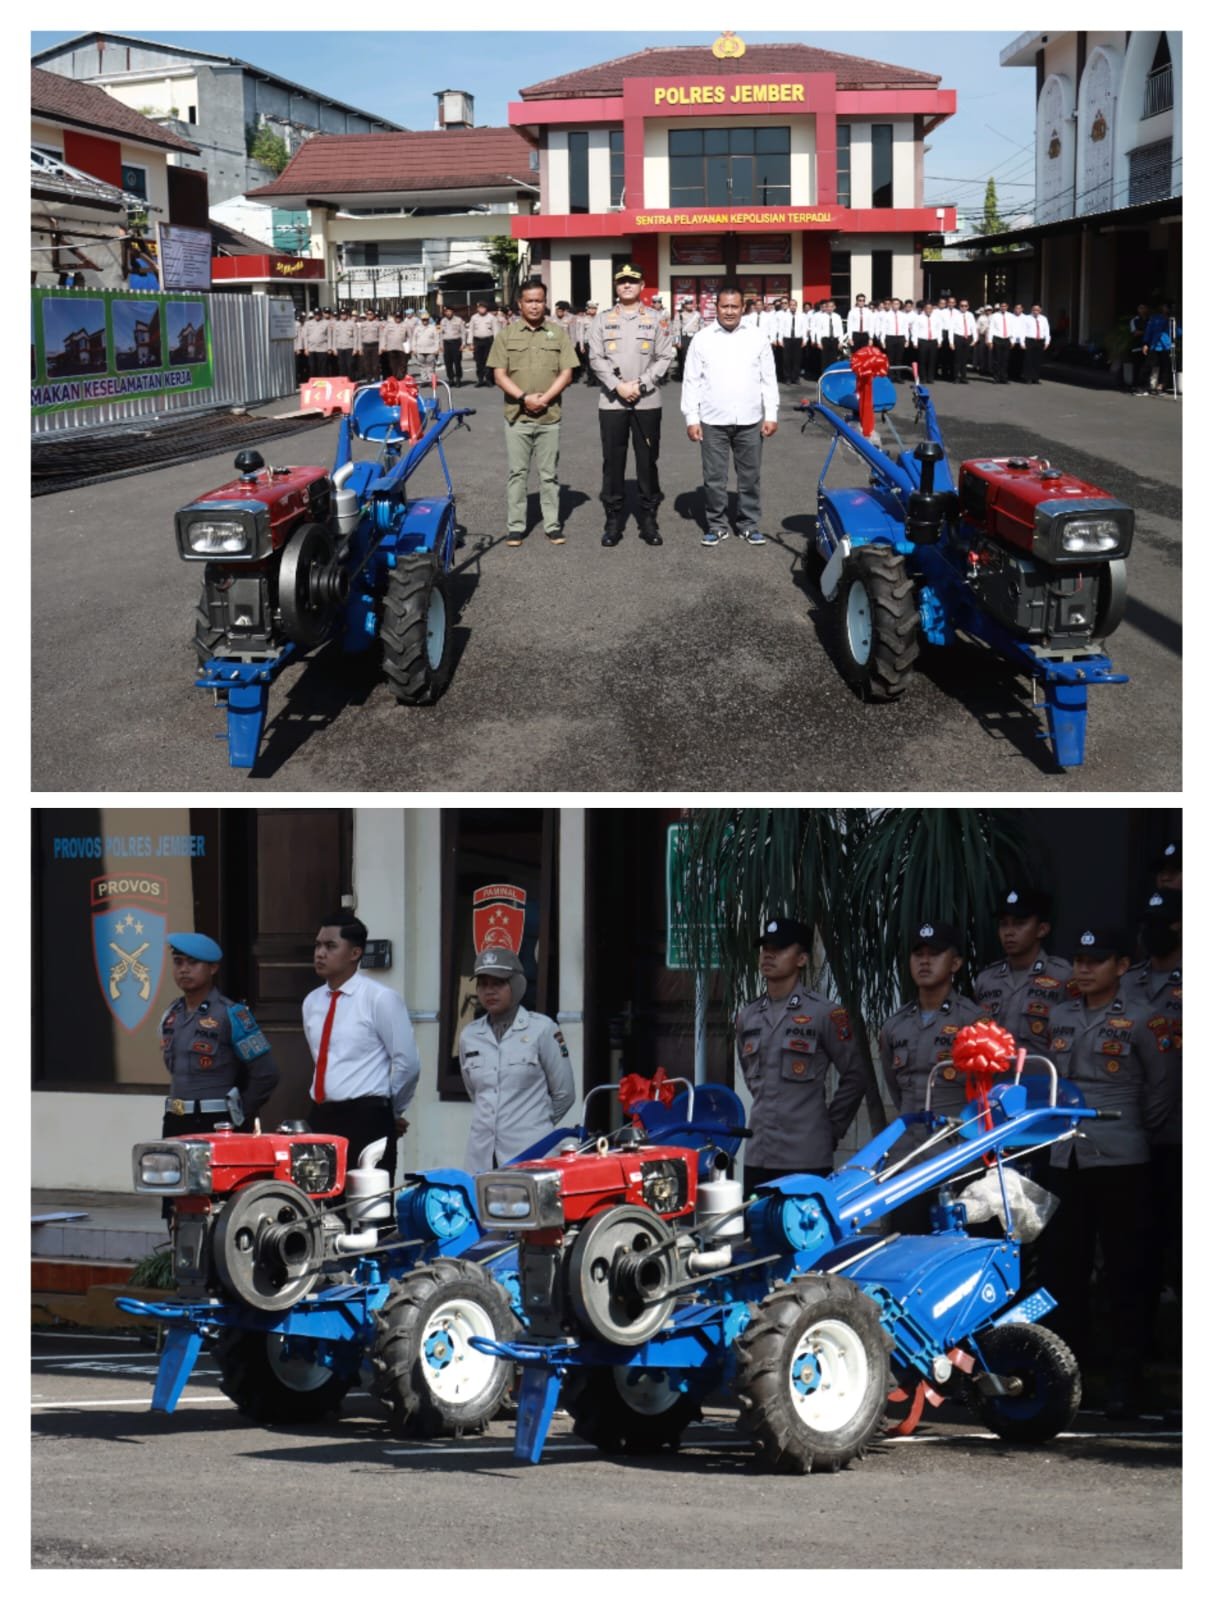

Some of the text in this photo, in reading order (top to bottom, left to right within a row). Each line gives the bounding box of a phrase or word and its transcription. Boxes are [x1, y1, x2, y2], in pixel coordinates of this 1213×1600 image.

[654, 83, 805, 104] POLRES JEMBER
[635, 212, 831, 225] SENTRA PELAYANAN KEPOLISIAN TERPADU
[84, 375, 162, 397] KESELAMATAN
[164, 370, 192, 387] KERJA
[53, 834, 206, 859] PROVOS POLRES JEMBER
[98, 879, 160, 897] PROVOS
[483, 887, 517, 898] PAMINAL
[1027, 988, 1059, 1000] POLRI
[1166, 1001, 1182, 1010] PO
[785, 1027, 817, 1037] POLRI
[1098, 1028, 1132, 1040] POLRI
[934, 1036, 953, 1047] POL
